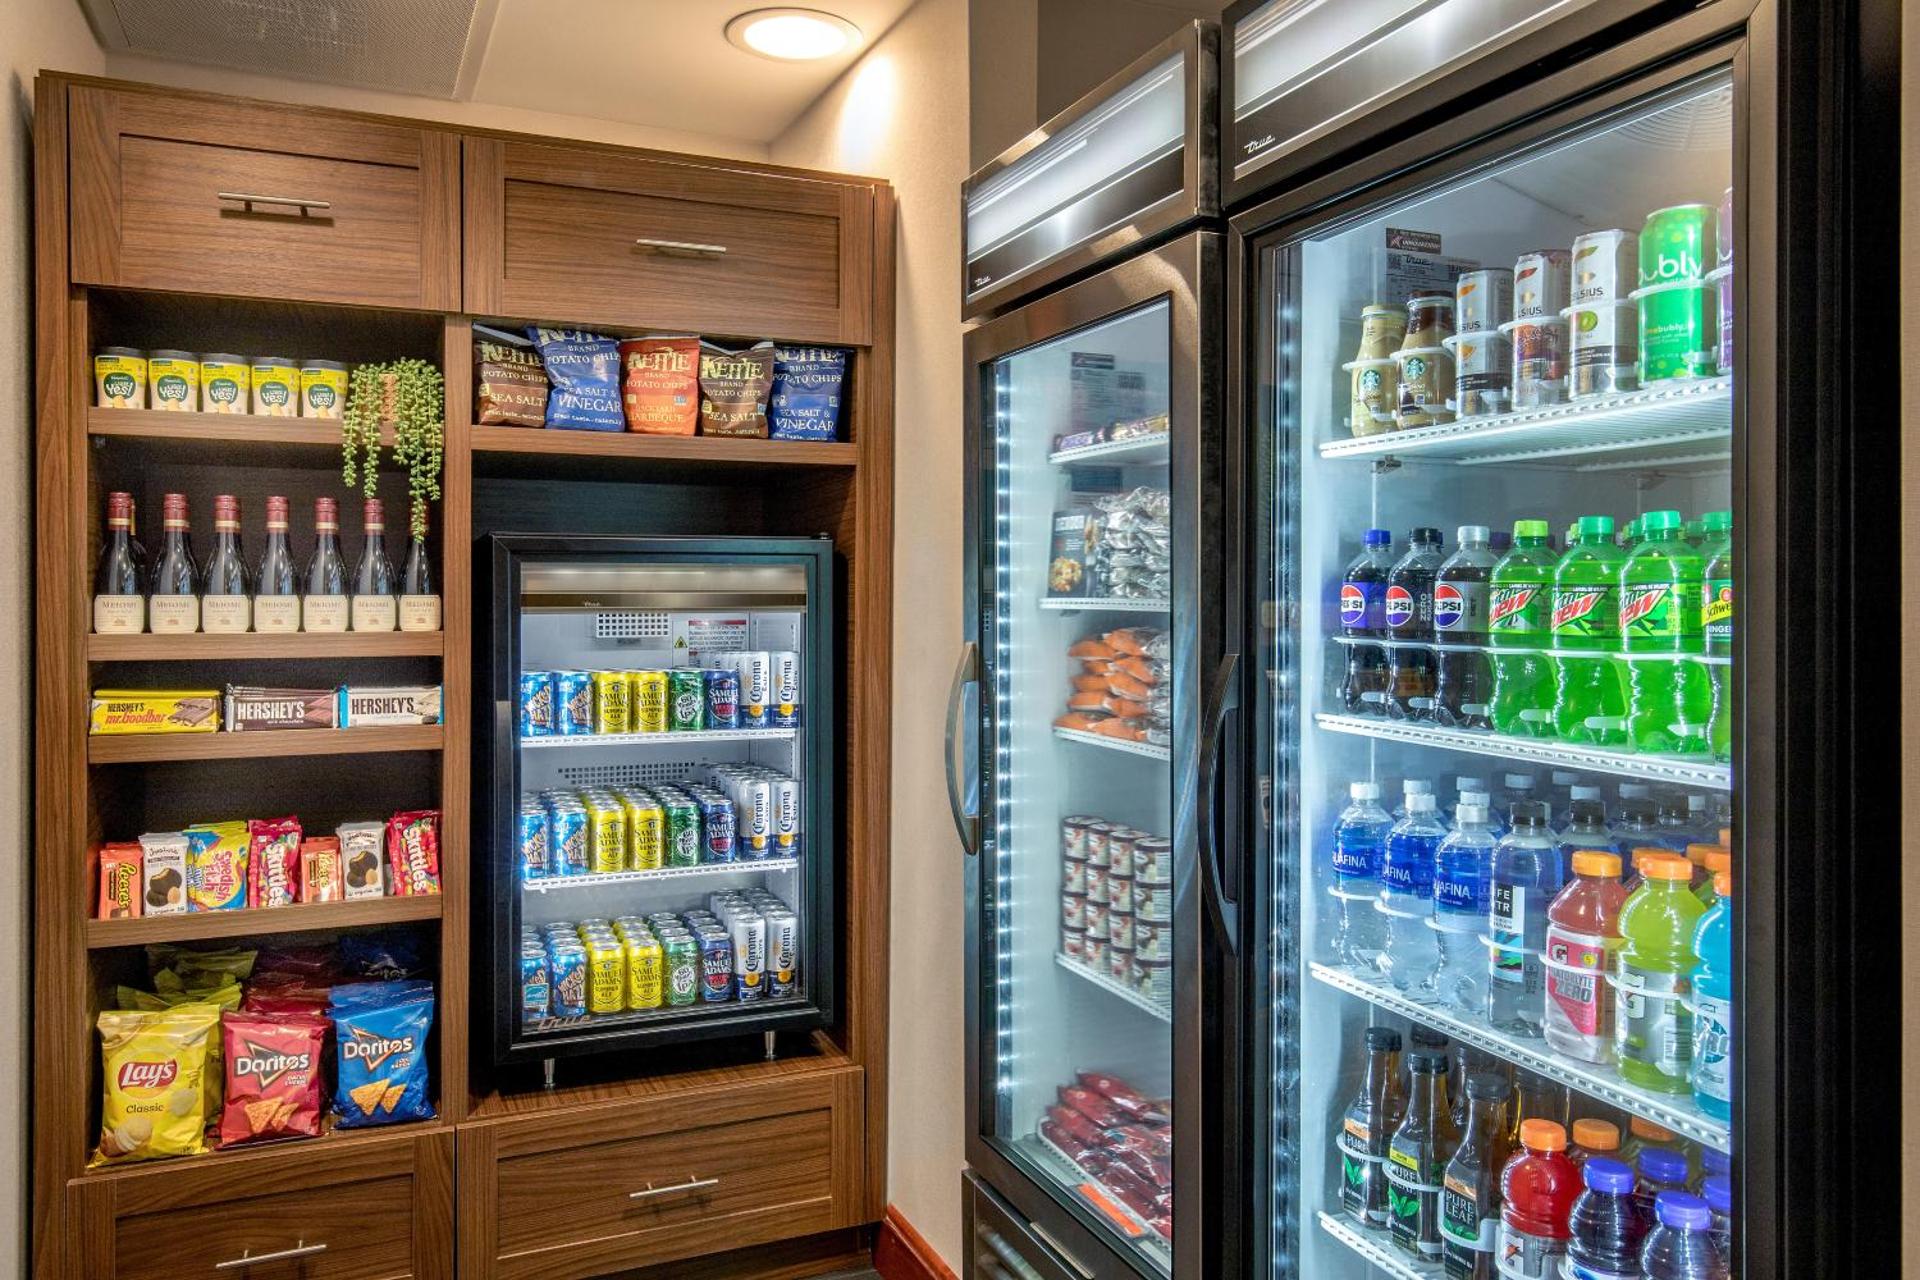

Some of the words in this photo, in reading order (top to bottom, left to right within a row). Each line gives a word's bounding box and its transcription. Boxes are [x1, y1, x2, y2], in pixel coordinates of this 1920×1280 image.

[490, 393, 514, 403] SEA
[516, 394, 546, 407] SALT
[584, 388, 608, 397] SALT
[558, 394, 622, 413] VINEGAR
[798, 409, 820, 418] SALT
[730, 412, 758, 422] SALT
[776, 418, 834, 431] VINEGAR
[750, 661, 762, 702] Corona
[237, 701, 305, 720] HERSHEY'S
[352, 697, 415, 715] HERSHEY'S
[402, 826, 429, 891] Skittles
[265, 843, 288, 908] Skittles
[119, 863, 137, 910] Reese's
[344, 1037, 413, 1060] Doritos
[121, 1060, 175, 1088] Lay's
[237, 1054, 310, 1076] Doritos
[126, 1103, 165, 1113] Classic
[1446, 1191, 1474, 1213] PURE
[1446, 1202, 1474, 1225] LEAF
